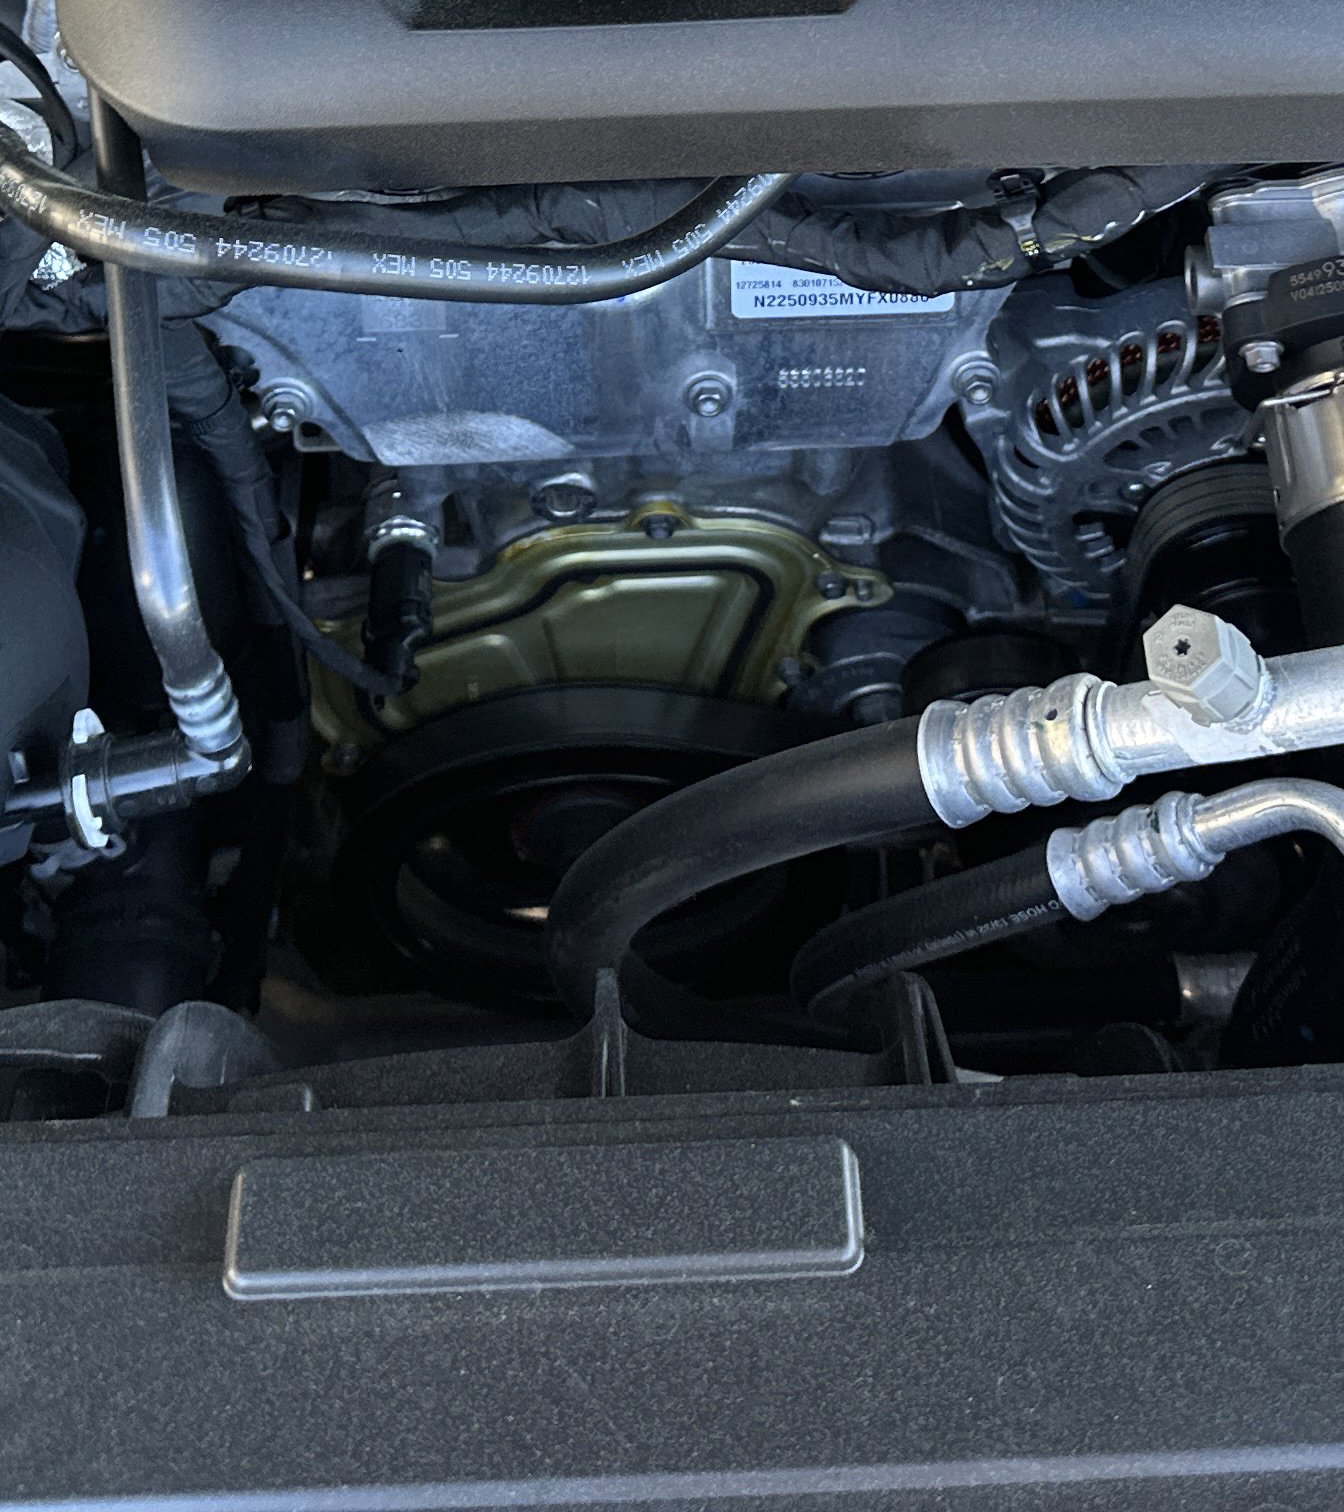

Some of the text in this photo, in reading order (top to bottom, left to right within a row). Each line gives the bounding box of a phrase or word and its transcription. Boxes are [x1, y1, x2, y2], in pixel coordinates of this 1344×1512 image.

[76, 208, 127, 240] MEX
[143, 226, 197, 254] 505
[371, 252, 593, 286] 12709244 505 MEX
